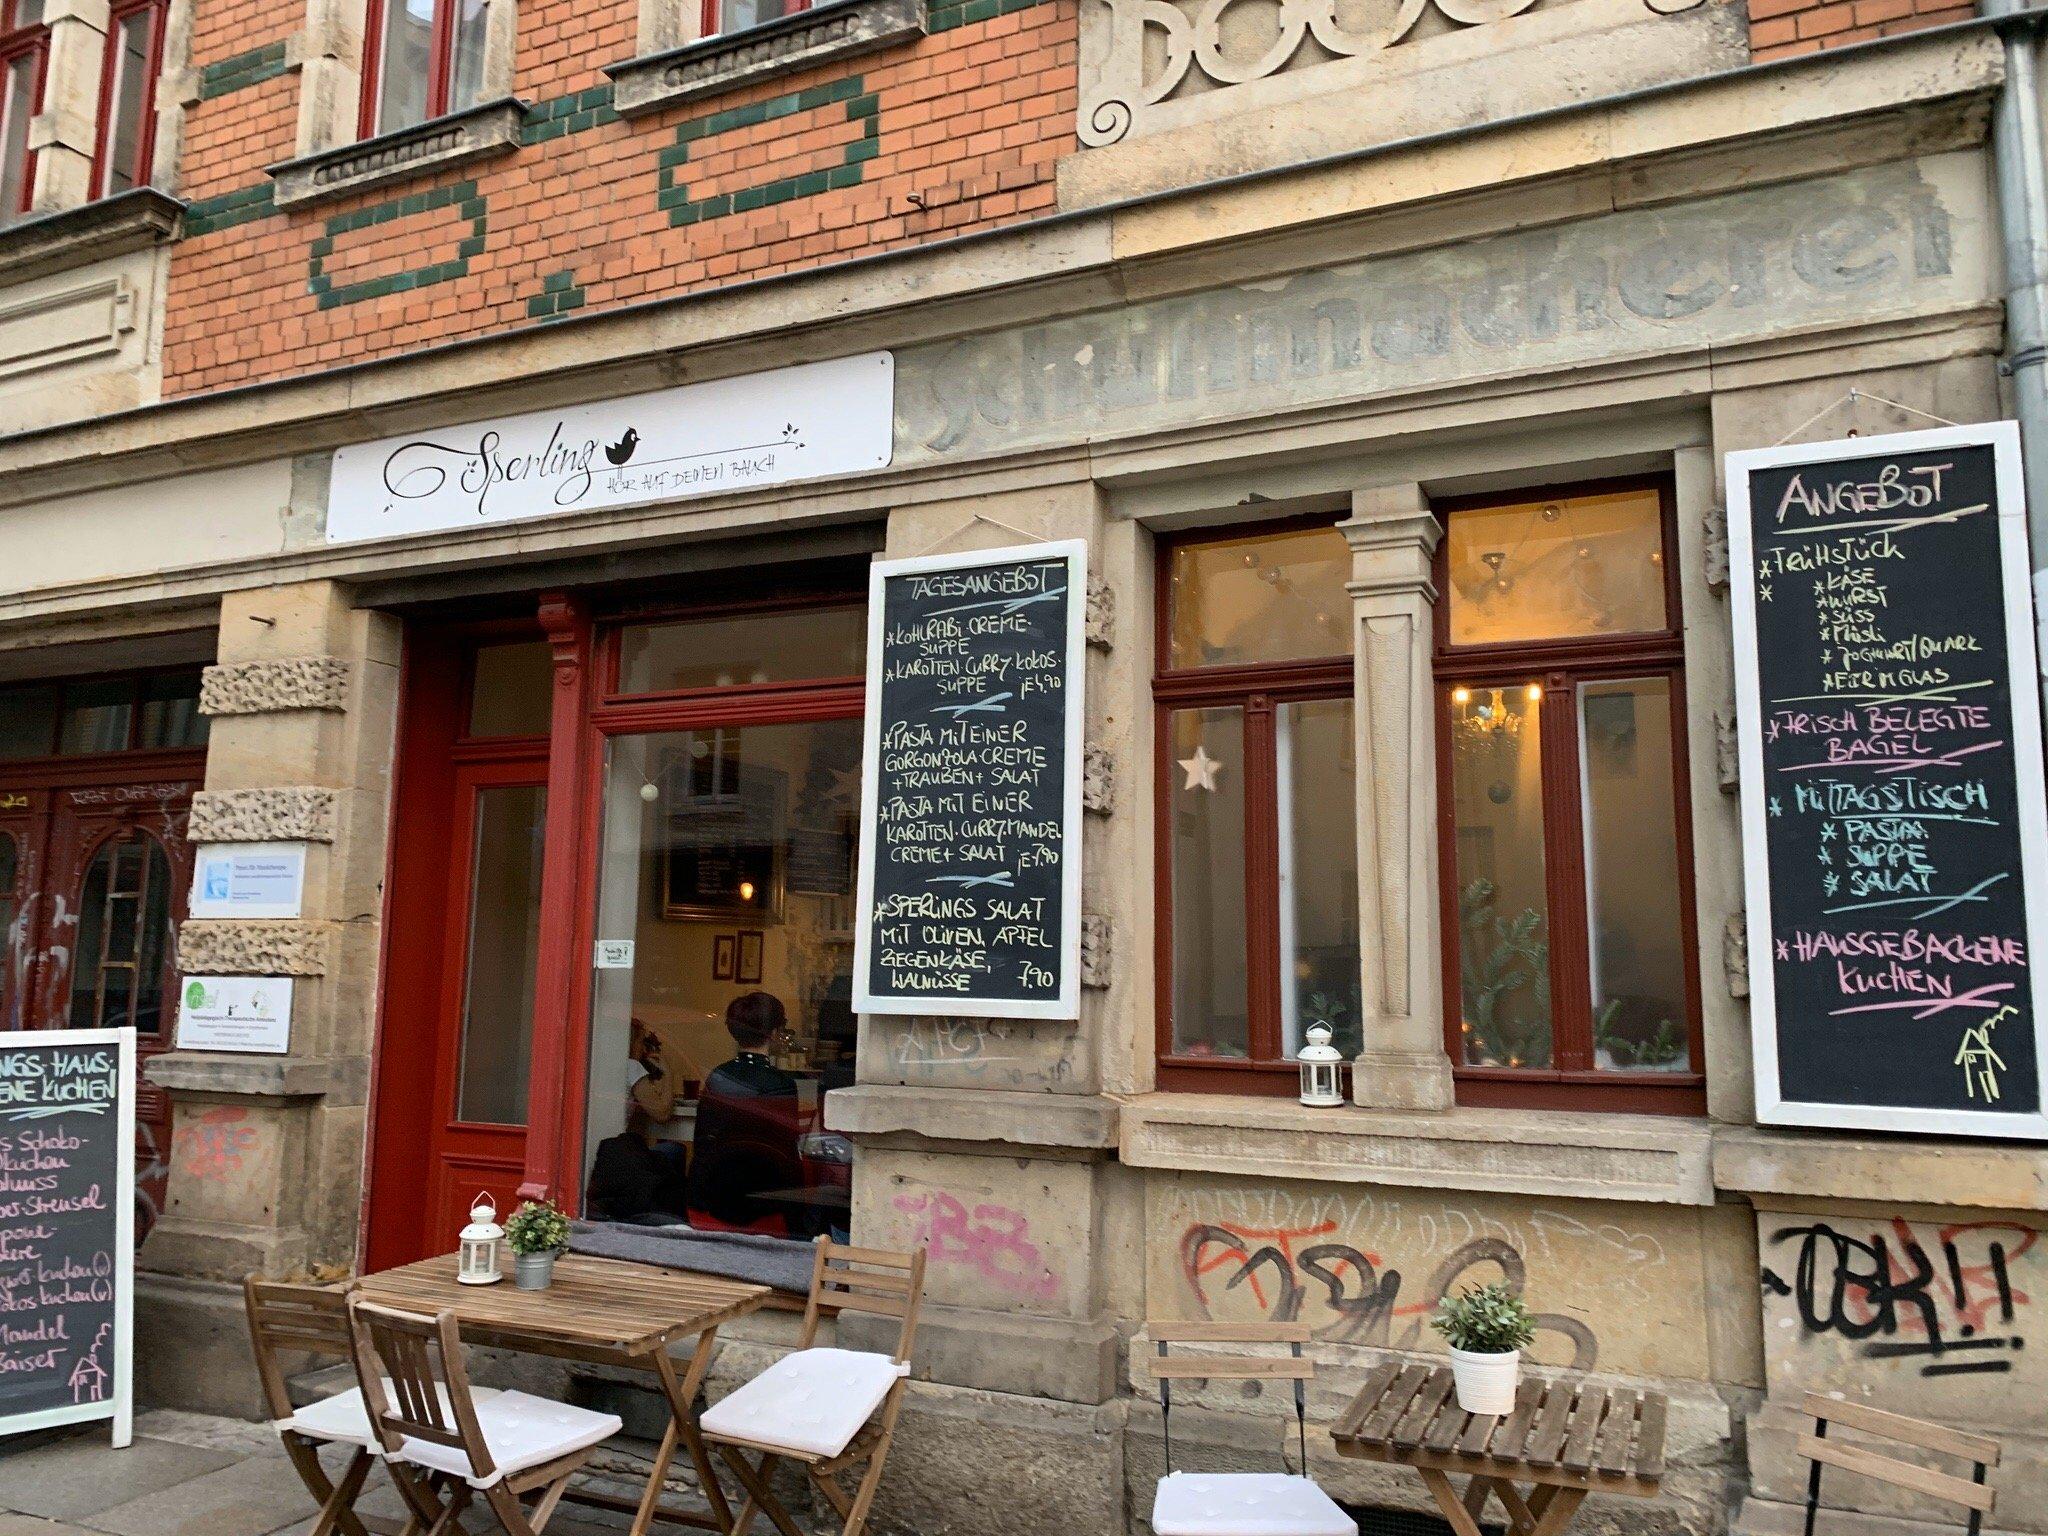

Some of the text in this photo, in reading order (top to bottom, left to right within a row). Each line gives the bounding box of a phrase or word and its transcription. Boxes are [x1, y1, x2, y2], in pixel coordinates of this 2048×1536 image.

[384, 420, 599, 515] Sperling
[1775, 462, 1954, 524] ANGEBOT
[905, 563, 1065, 601] TAGESANGEBOT
[1898, 667, 1950, 688] GLAS
[1863, 705, 1992, 734] BELEGTE
[889, 720, 935, 751] PASTA
[1824, 733, 1933, 763] BAGEL
[989, 766, 1040, 787] SALAT
[887, 795, 935, 822] PASTA
[958, 843, 1007, 863] SALAT
[1849, 869, 1939, 897] SALAT
[983, 897, 1048, 922] SALAT
[1792, 929, 2027, 967] HAUSGEBACKENE
[42, 1068, 116, 1101] KUCHEN
